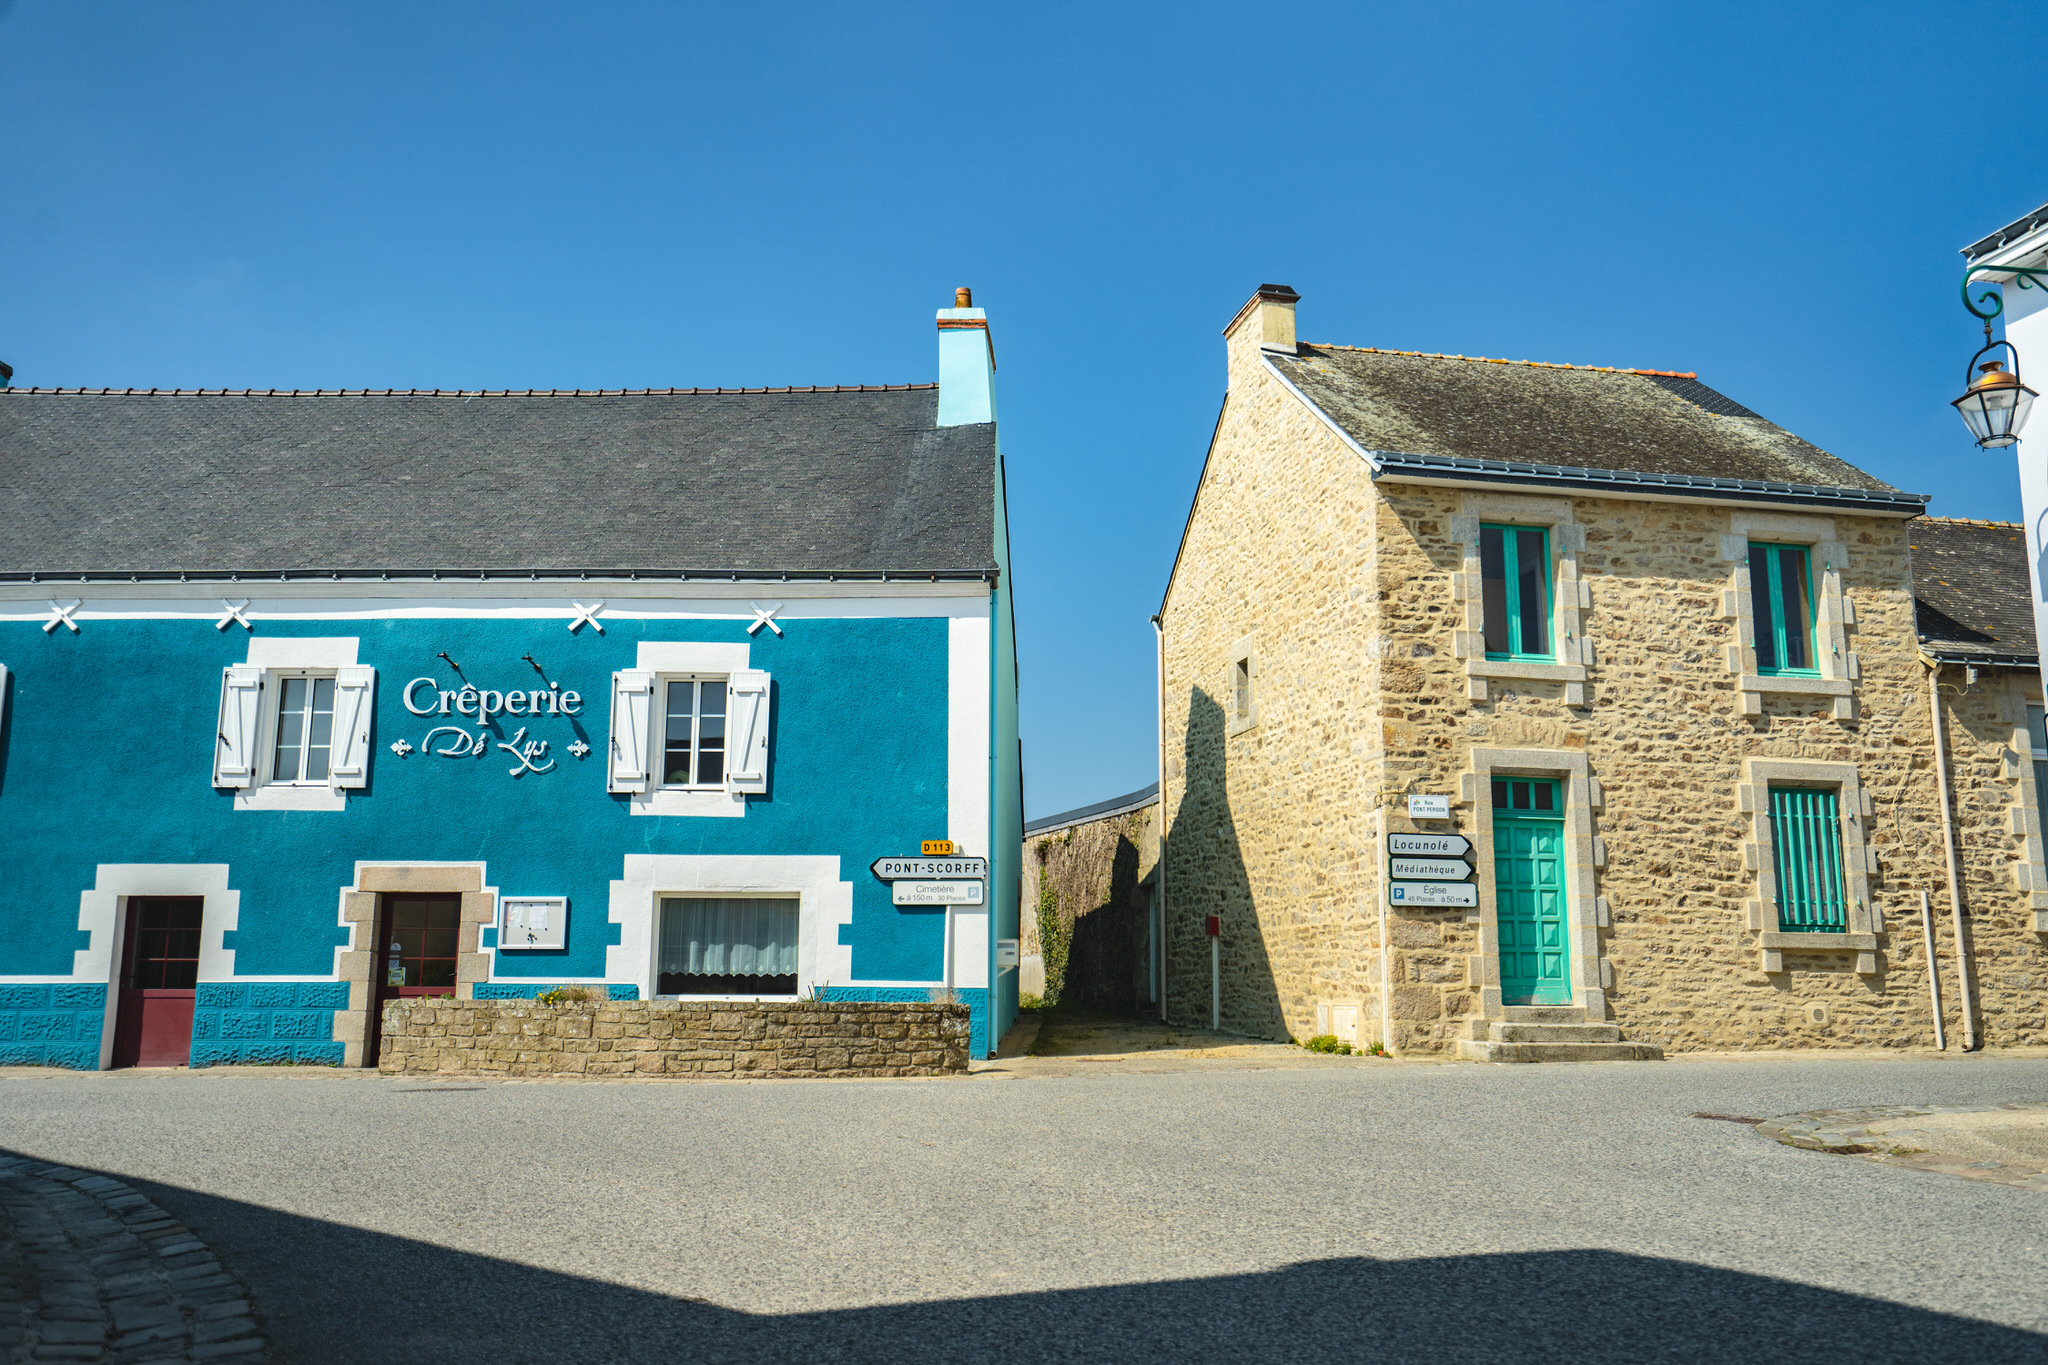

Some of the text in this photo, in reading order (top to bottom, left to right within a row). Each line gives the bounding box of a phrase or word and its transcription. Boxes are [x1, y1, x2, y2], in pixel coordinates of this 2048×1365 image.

[403, 677, 581, 725] Crêperie
[497, 727, 555, 776] Lys
[924, 843, 951, 852] D 113
[1394, 839, 1449, 851] Locunolé
[885, 863, 980, 873] PONT-SCORFF
[1395, 864, 1456, 876] Médiathèque
[915, 884, 955, 893] Cimetière
[1423, 884, 1447, 896] Église
